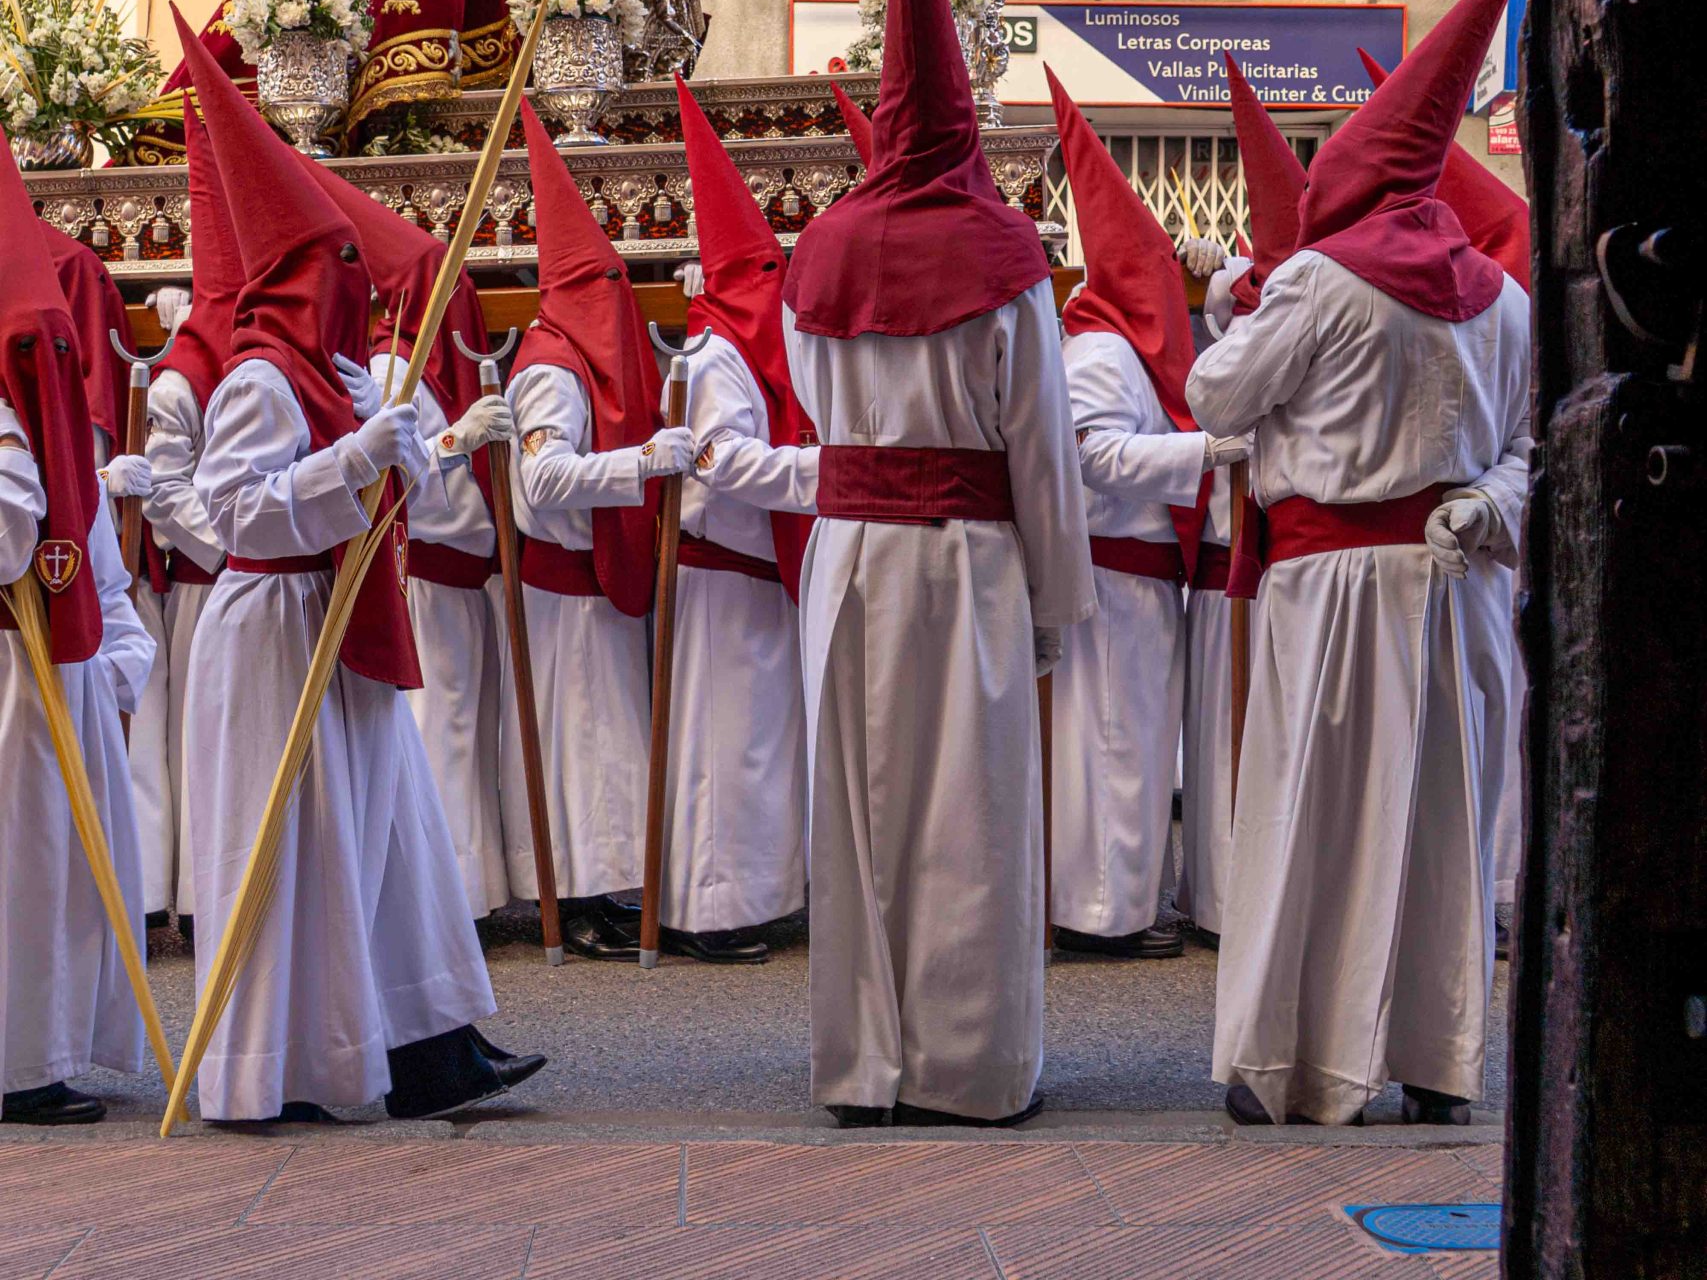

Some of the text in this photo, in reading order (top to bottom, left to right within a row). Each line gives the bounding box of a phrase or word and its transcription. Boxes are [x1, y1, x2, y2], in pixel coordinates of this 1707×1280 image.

[1085, 9, 1180, 26] Luminosos
[1118, 33, 1271, 55] Letras Corporeas
[1148, 61, 1318, 78] Vallas Pulicitarias
[1178, 84, 1232, 101] Vinilo
[1311, 85, 1327, 102] &
[1332, 84, 1373, 102] Cutt
